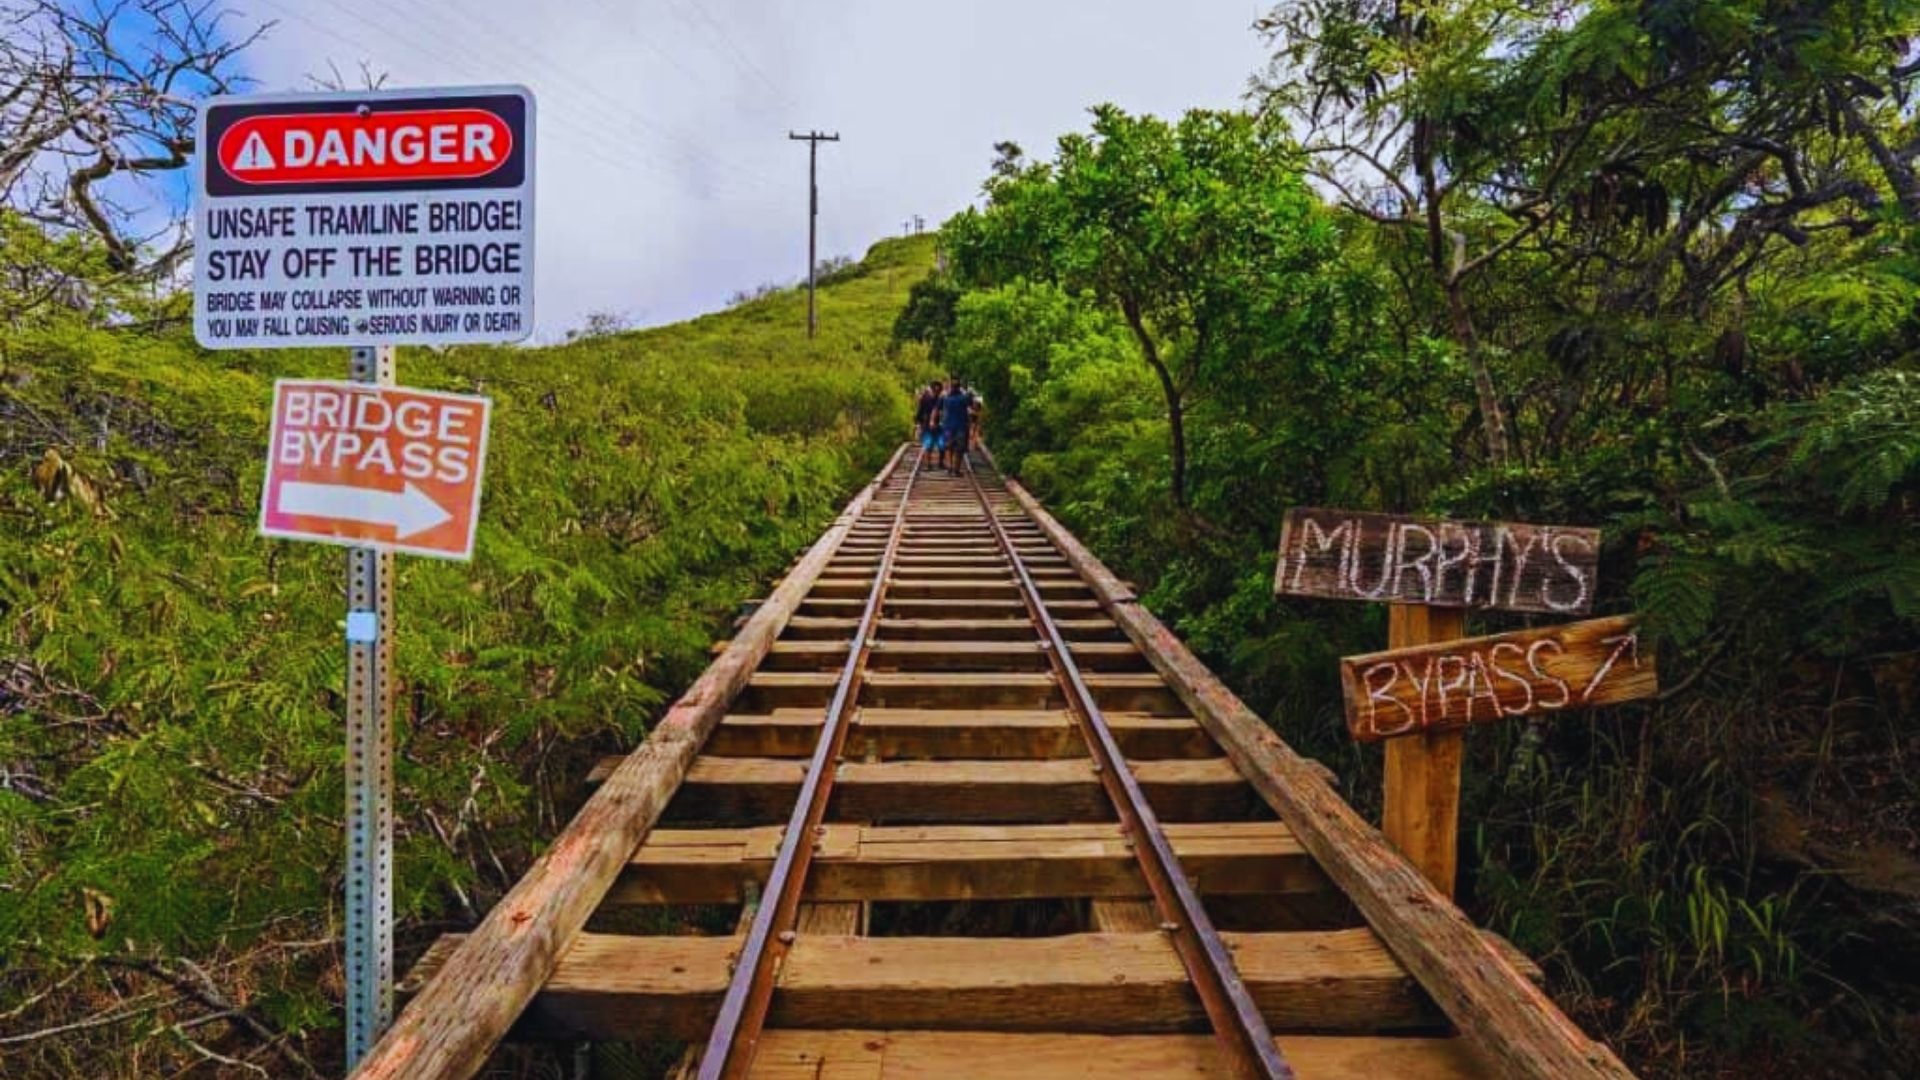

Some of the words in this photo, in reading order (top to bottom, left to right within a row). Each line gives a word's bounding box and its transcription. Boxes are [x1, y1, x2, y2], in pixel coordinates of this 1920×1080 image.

[284, 124, 496, 168] DANGER
[207, 207, 296, 240] UNSAFE
[305, 203, 419, 236] TRAMLINE
[428, 200, 522, 232] BRIDGE!
[208, 249, 270, 282] STAY
[283, 248, 337, 279] OFF
[348, 246, 403, 277] THE
[415, 243, 521, 275] BRIDGE
[207, 291, 256, 312] BRIDGE
[260, 290, 287, 311] MAY
[292, 289, 362, 311] COLLAPSE
[367, 287, 427, 309] WITHOUT
[432, 285, 496, 307] WARNING
[500, 285, 521, 306] OR
[208, 318, 232, 337] YOU
[236, 317, 259, 337] MAY
[263, 316, 292, 336] FALL
[295, 315, 349, 336] CAUSING
[369, 313, 417, 335] SERIOUS
[421, 312, 460, 334] INJURY
[464, 312, 481, 333] OR
[484, 311, 520, 333] DEATH
[284, 391, 475, 444] BRIDGE
[278, 430, 470, 484] BYPASS
[1291, 517, 1594, 611] MURPHY'S
[1363, 639, 1569, 735] BYPASS
